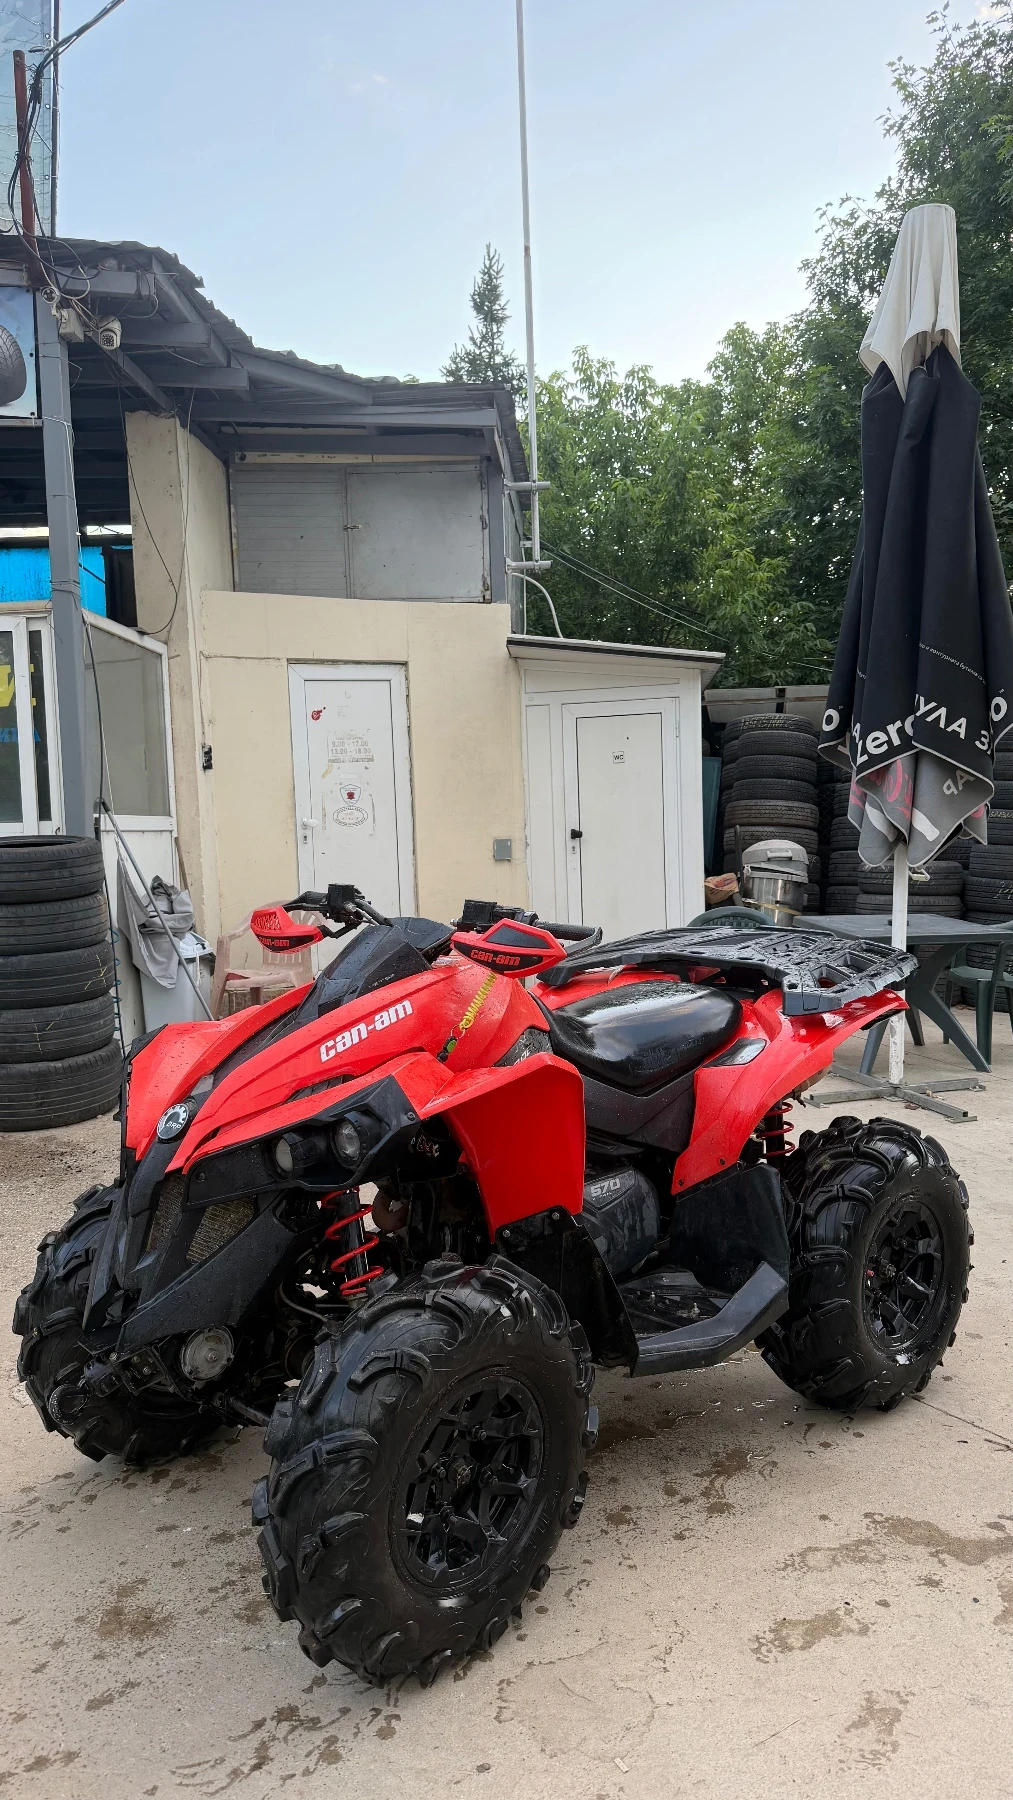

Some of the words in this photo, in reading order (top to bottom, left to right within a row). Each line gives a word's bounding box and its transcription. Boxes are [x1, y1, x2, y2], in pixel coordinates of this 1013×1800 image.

[915, 693, 967, 740] УЛА
[469, 950, 521, 967] can-am
[320, 999, 414, 1063] can-am
[590, 1177, 621, 1197] 570
